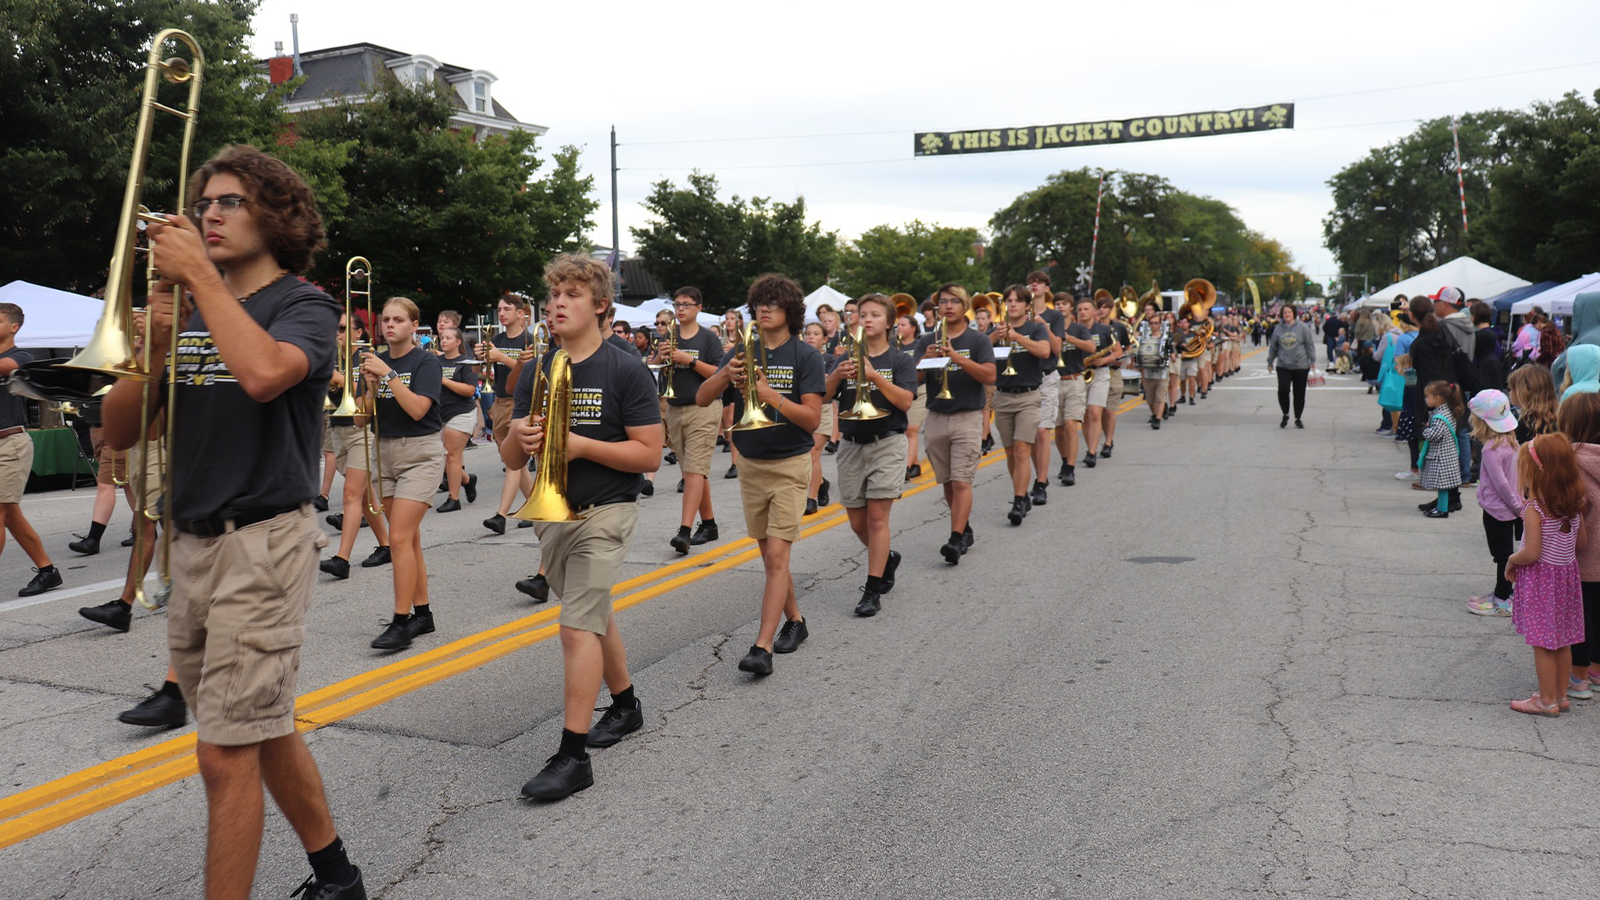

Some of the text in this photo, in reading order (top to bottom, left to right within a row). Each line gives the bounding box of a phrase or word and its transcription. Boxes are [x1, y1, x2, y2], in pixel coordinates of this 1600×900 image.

[949, 110, 1254, 150] THIS IS JACKET COUNTRY!
[571, 393, 602, 406] HING
[571, 406, 602, 418] ACKETS
